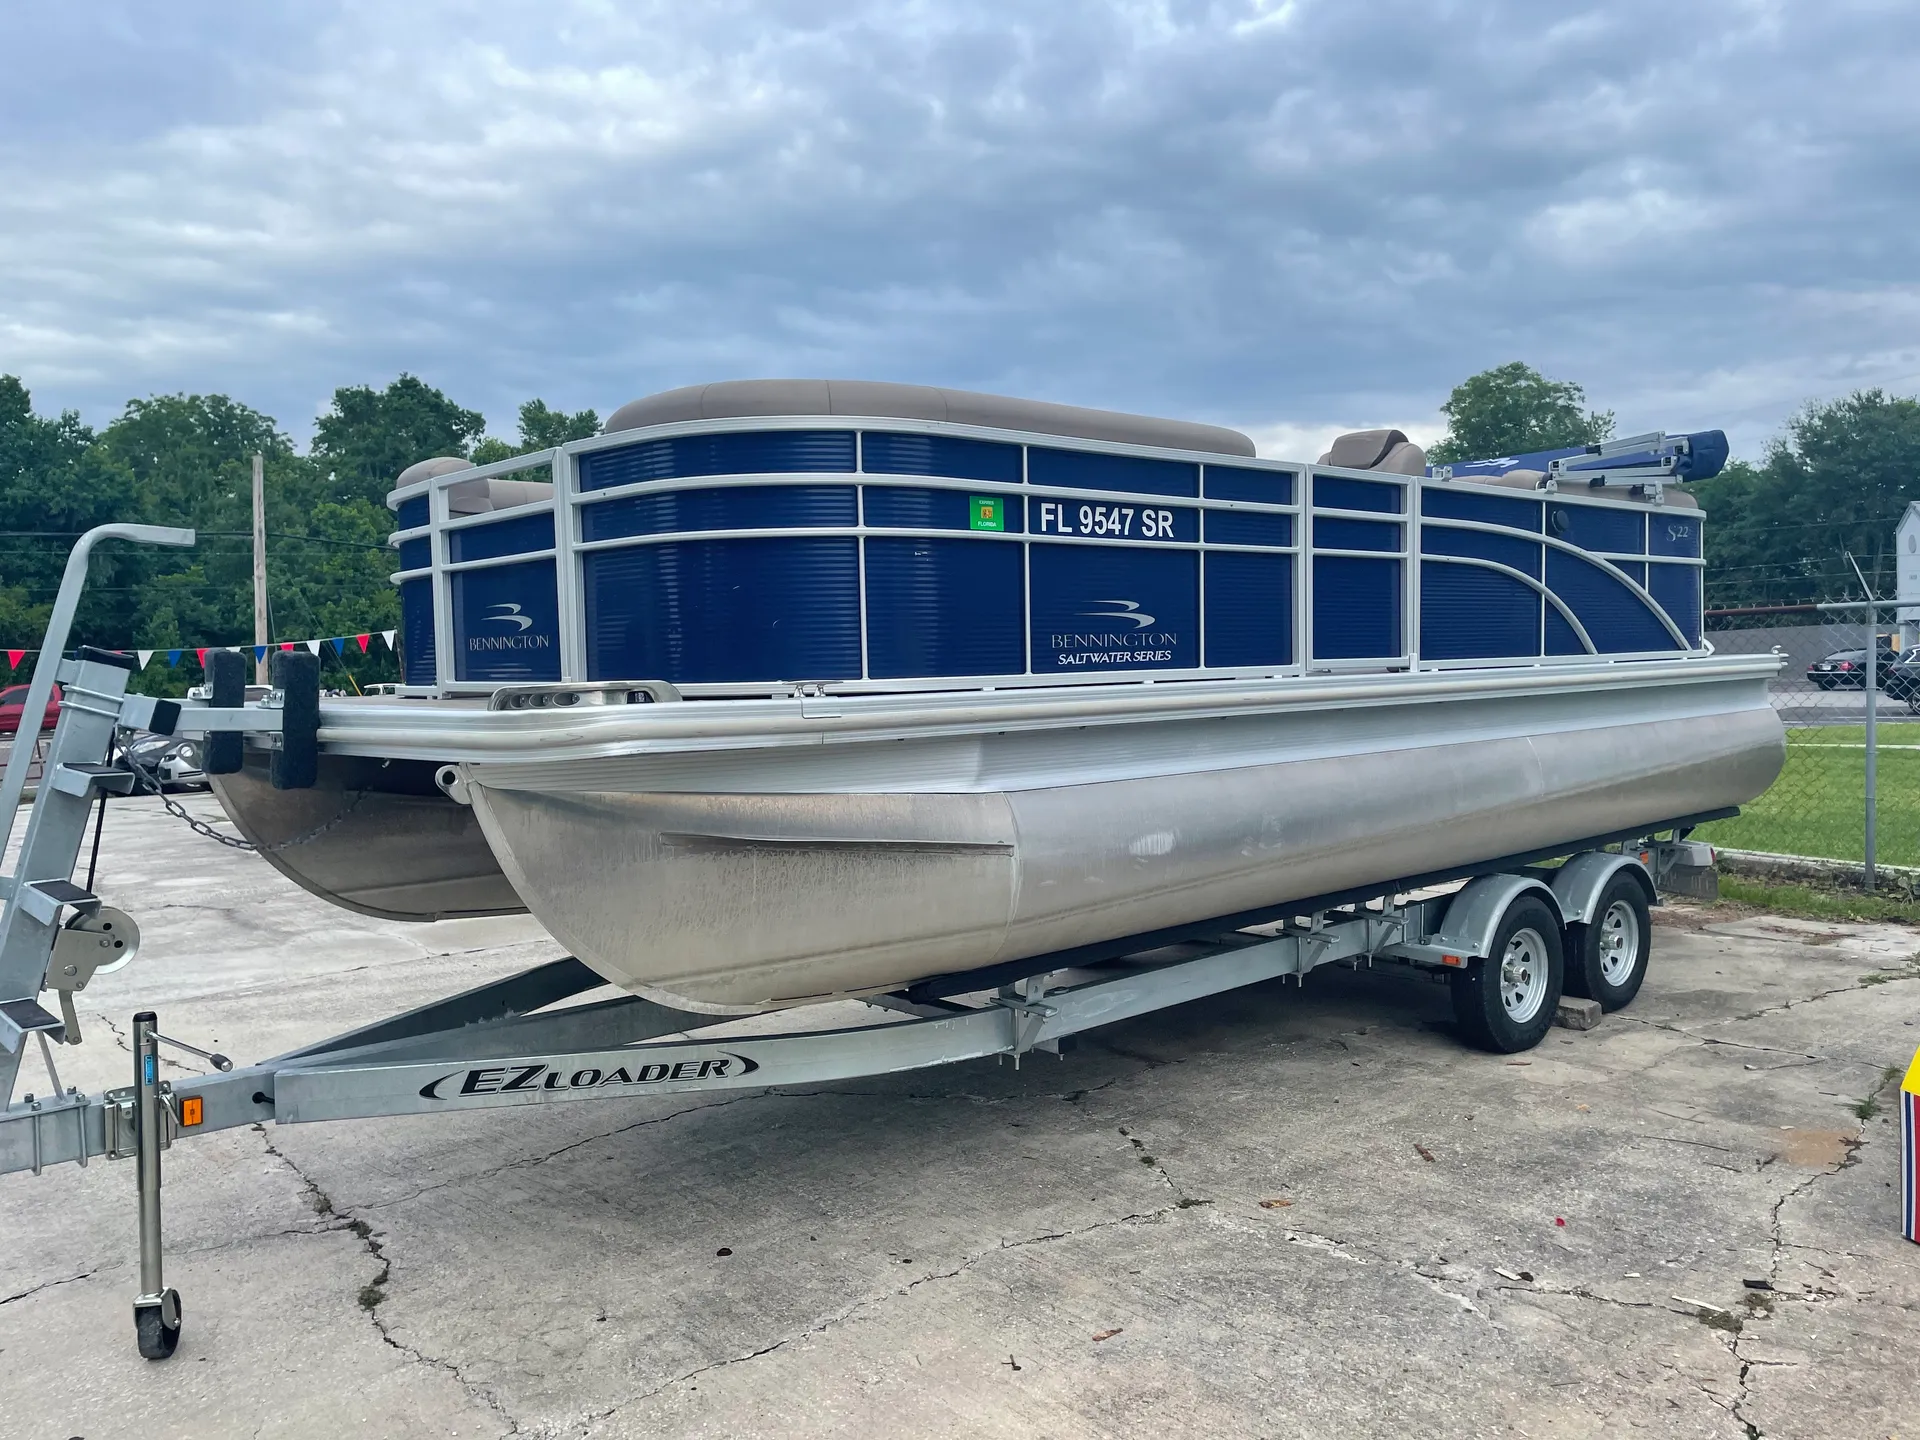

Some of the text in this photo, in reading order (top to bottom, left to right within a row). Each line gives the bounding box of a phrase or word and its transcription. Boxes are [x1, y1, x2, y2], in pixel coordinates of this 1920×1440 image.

[1040, 502, 1175, 538] FL 9547 SR
[469, 634, 549, 651] BENNINGTON
[1051, 632, 1177, 648] BENNINGTON
[1058, 650, 1172, 665] SALTWATER SERIES
